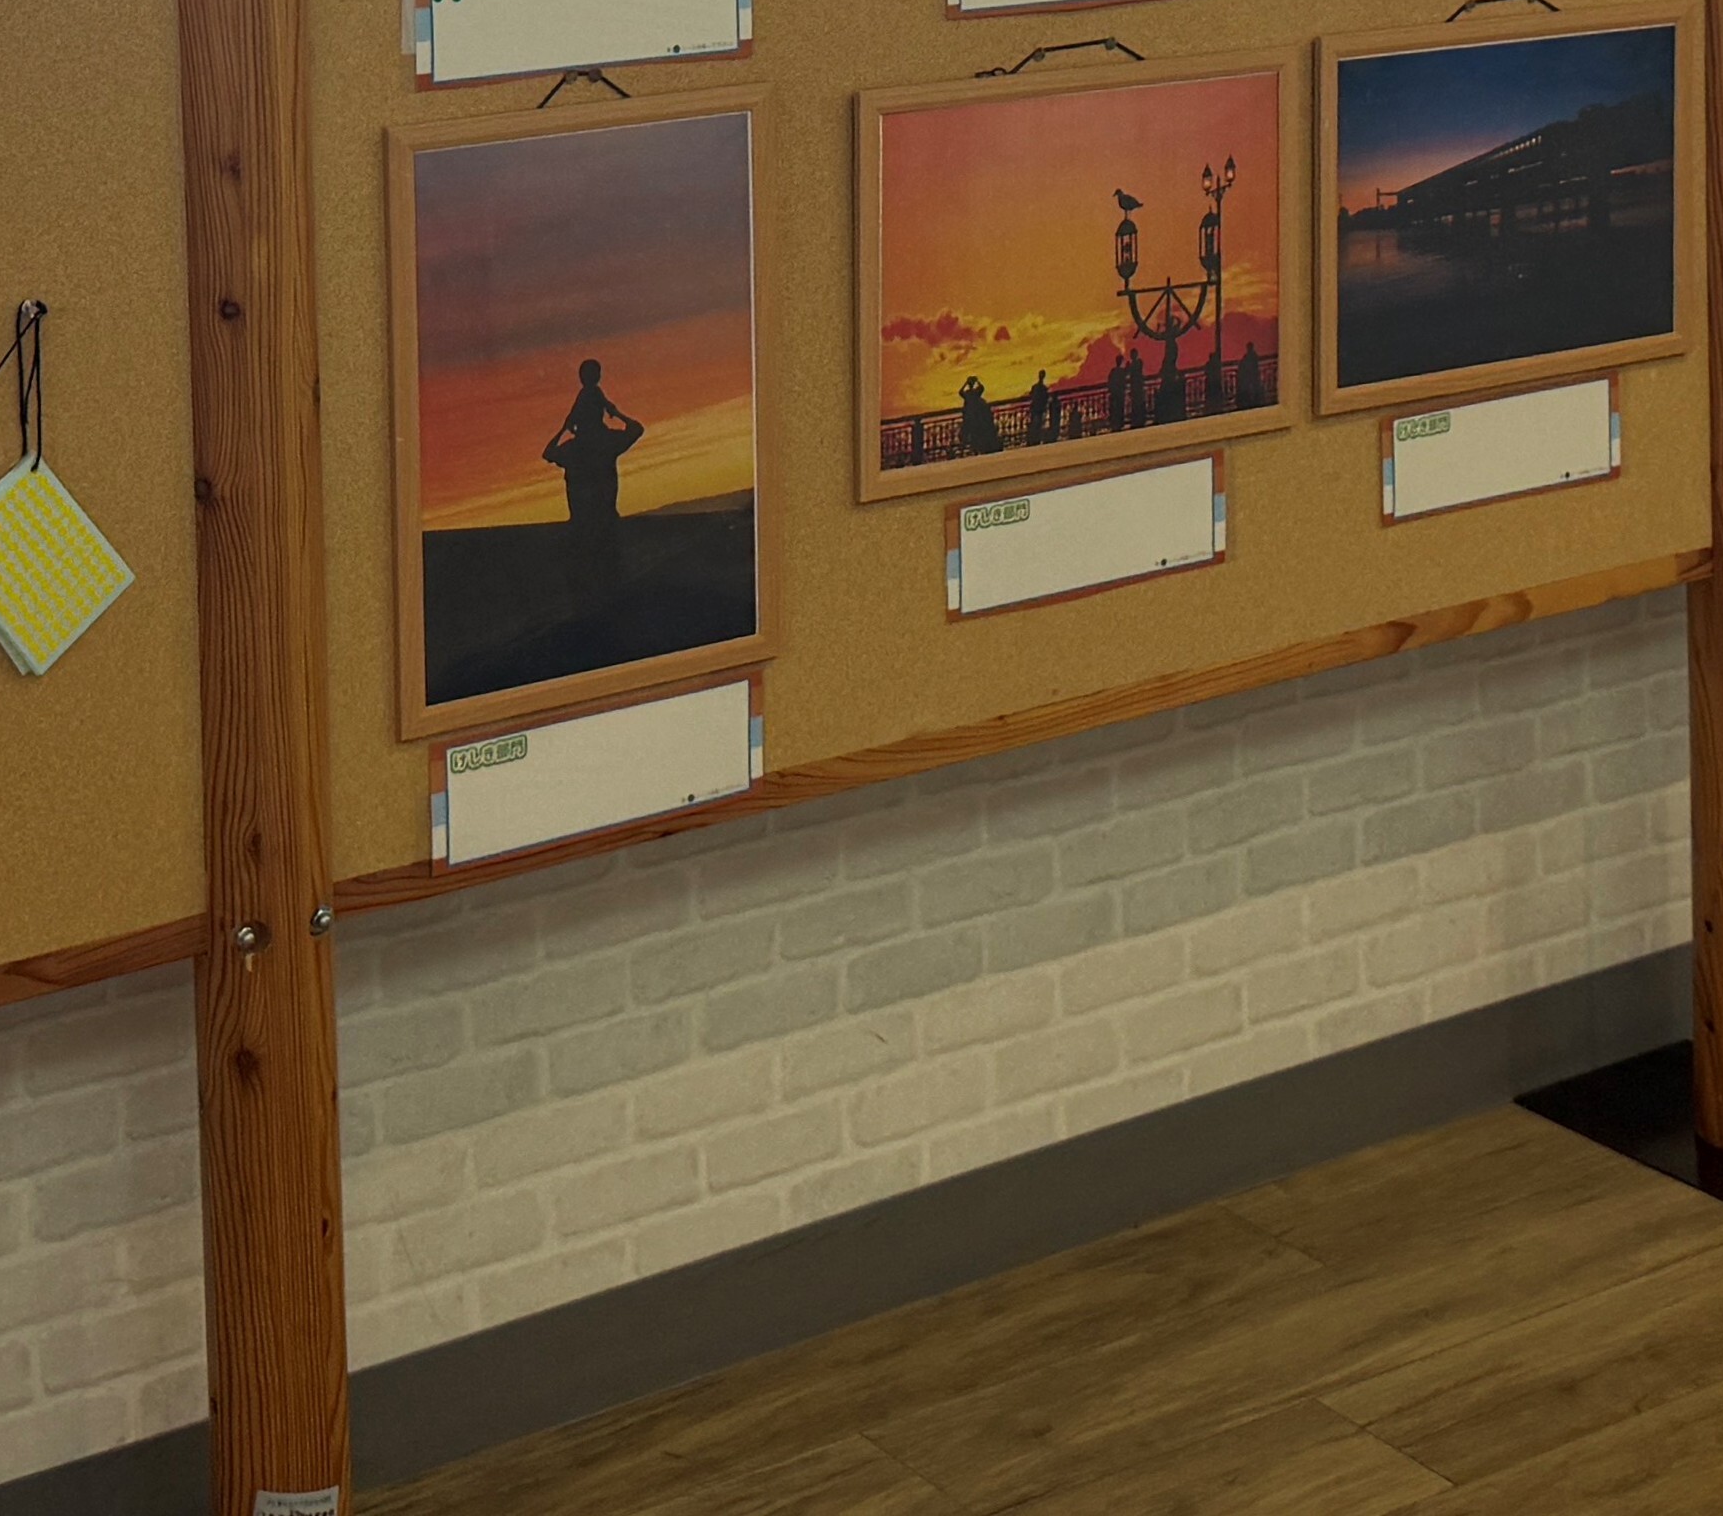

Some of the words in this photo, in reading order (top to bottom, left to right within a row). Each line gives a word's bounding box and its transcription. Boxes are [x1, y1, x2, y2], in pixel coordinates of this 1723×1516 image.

[450, 734, 528, 774] けしき部門
